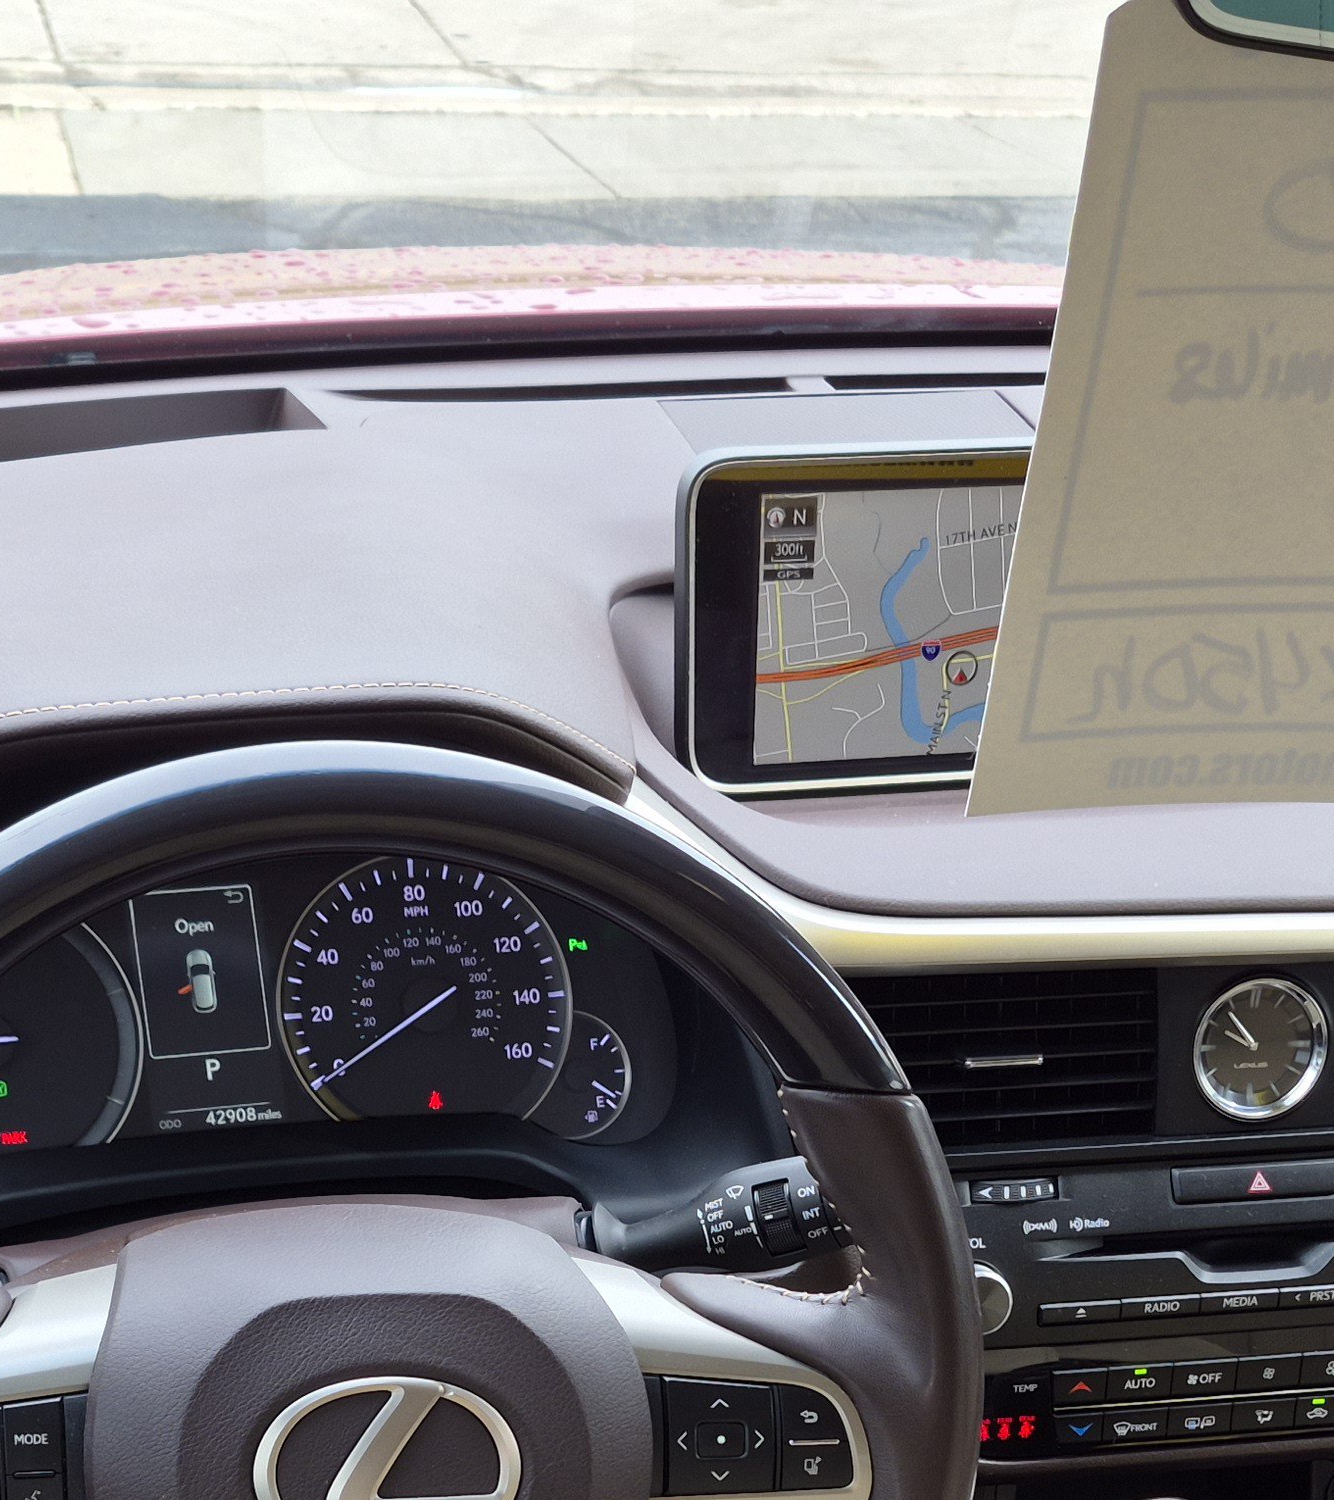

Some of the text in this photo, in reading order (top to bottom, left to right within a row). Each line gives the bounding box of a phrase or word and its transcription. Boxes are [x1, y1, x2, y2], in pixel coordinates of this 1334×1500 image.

[793, 508, 806, 525] N
[946, 529, 976, 545] 17TH
[981, 523, 1005, 539] AVE
[775, 543, 804, 557] 300ft
[777, 570, 801, 579] GPS
[926, 722, 943, 757] MAIN
[935, 703, 948, 720] ST
[403, 885, 425, 901] 80
[403, 906, 429, 917] MPH
[454, 900, 483, 917] 100
[351, 907, 374, 924] 60
[175, 918, 215, 936] Open
[402, 938, 419, 948] 120
[425, 936, 442, 946] 140
[493, 936, 521, 953] 120
[383, 948, 400, 958] 100
[445, 944, 462, 954] 160
[317, 949, 339, 965] 40
[411, 957, 435, 966] km/h
[460, 957, 477, 967] 180
[370, 961, 384, 971] 80
[362, 978, 375, 988] 60
[468, 972, 487, 982] 200
[475, 990, 493, 1000] 220
[512, 988, 540, 1005] 140
[360, 997, 373, 1007] 40
[310, 1006, 333, 1022] 20
[475, 1009, 494, 1018] 240
[363, 1017, 376, 1027] 20
[471, 1027, 489, 1037] 260
[590, 1038, 598, 1051] F
[503, 1042, 532, 1060] 160
[205, 1059, 221, 1081] P
[596, 1096, 605, 1108] E
[205, 1108, 257, 1126] 42908
[797, 1185, 815, 1198] ON
[707, 1210, 724, 1222] OFF
[802, 1207, 820, 1221] INT
[710, 1221, 733, 1234] AUTO
[1084, 1218, 1110, 1228] Radio
[734, 1227, 752, 1237] AUTO
[808, 1226, 829, 1239] OFF
[712, 1235, 724, 1245] LO
[968, 1238, 987, 1249] OL
[1144, 1302, 1180, 1313] RADIO
[1223, 1295, 1258, 1308] MEDIA
[1124, 1377, 1156, 1390] AUTO
[1199, 1372, 1223, 1385] OFF
[1013, 1383, 1038, 1393] TEMP
[1130, 1422, 1158, 1432] FRONT
[14, 1433, 49, 1445] MODE
